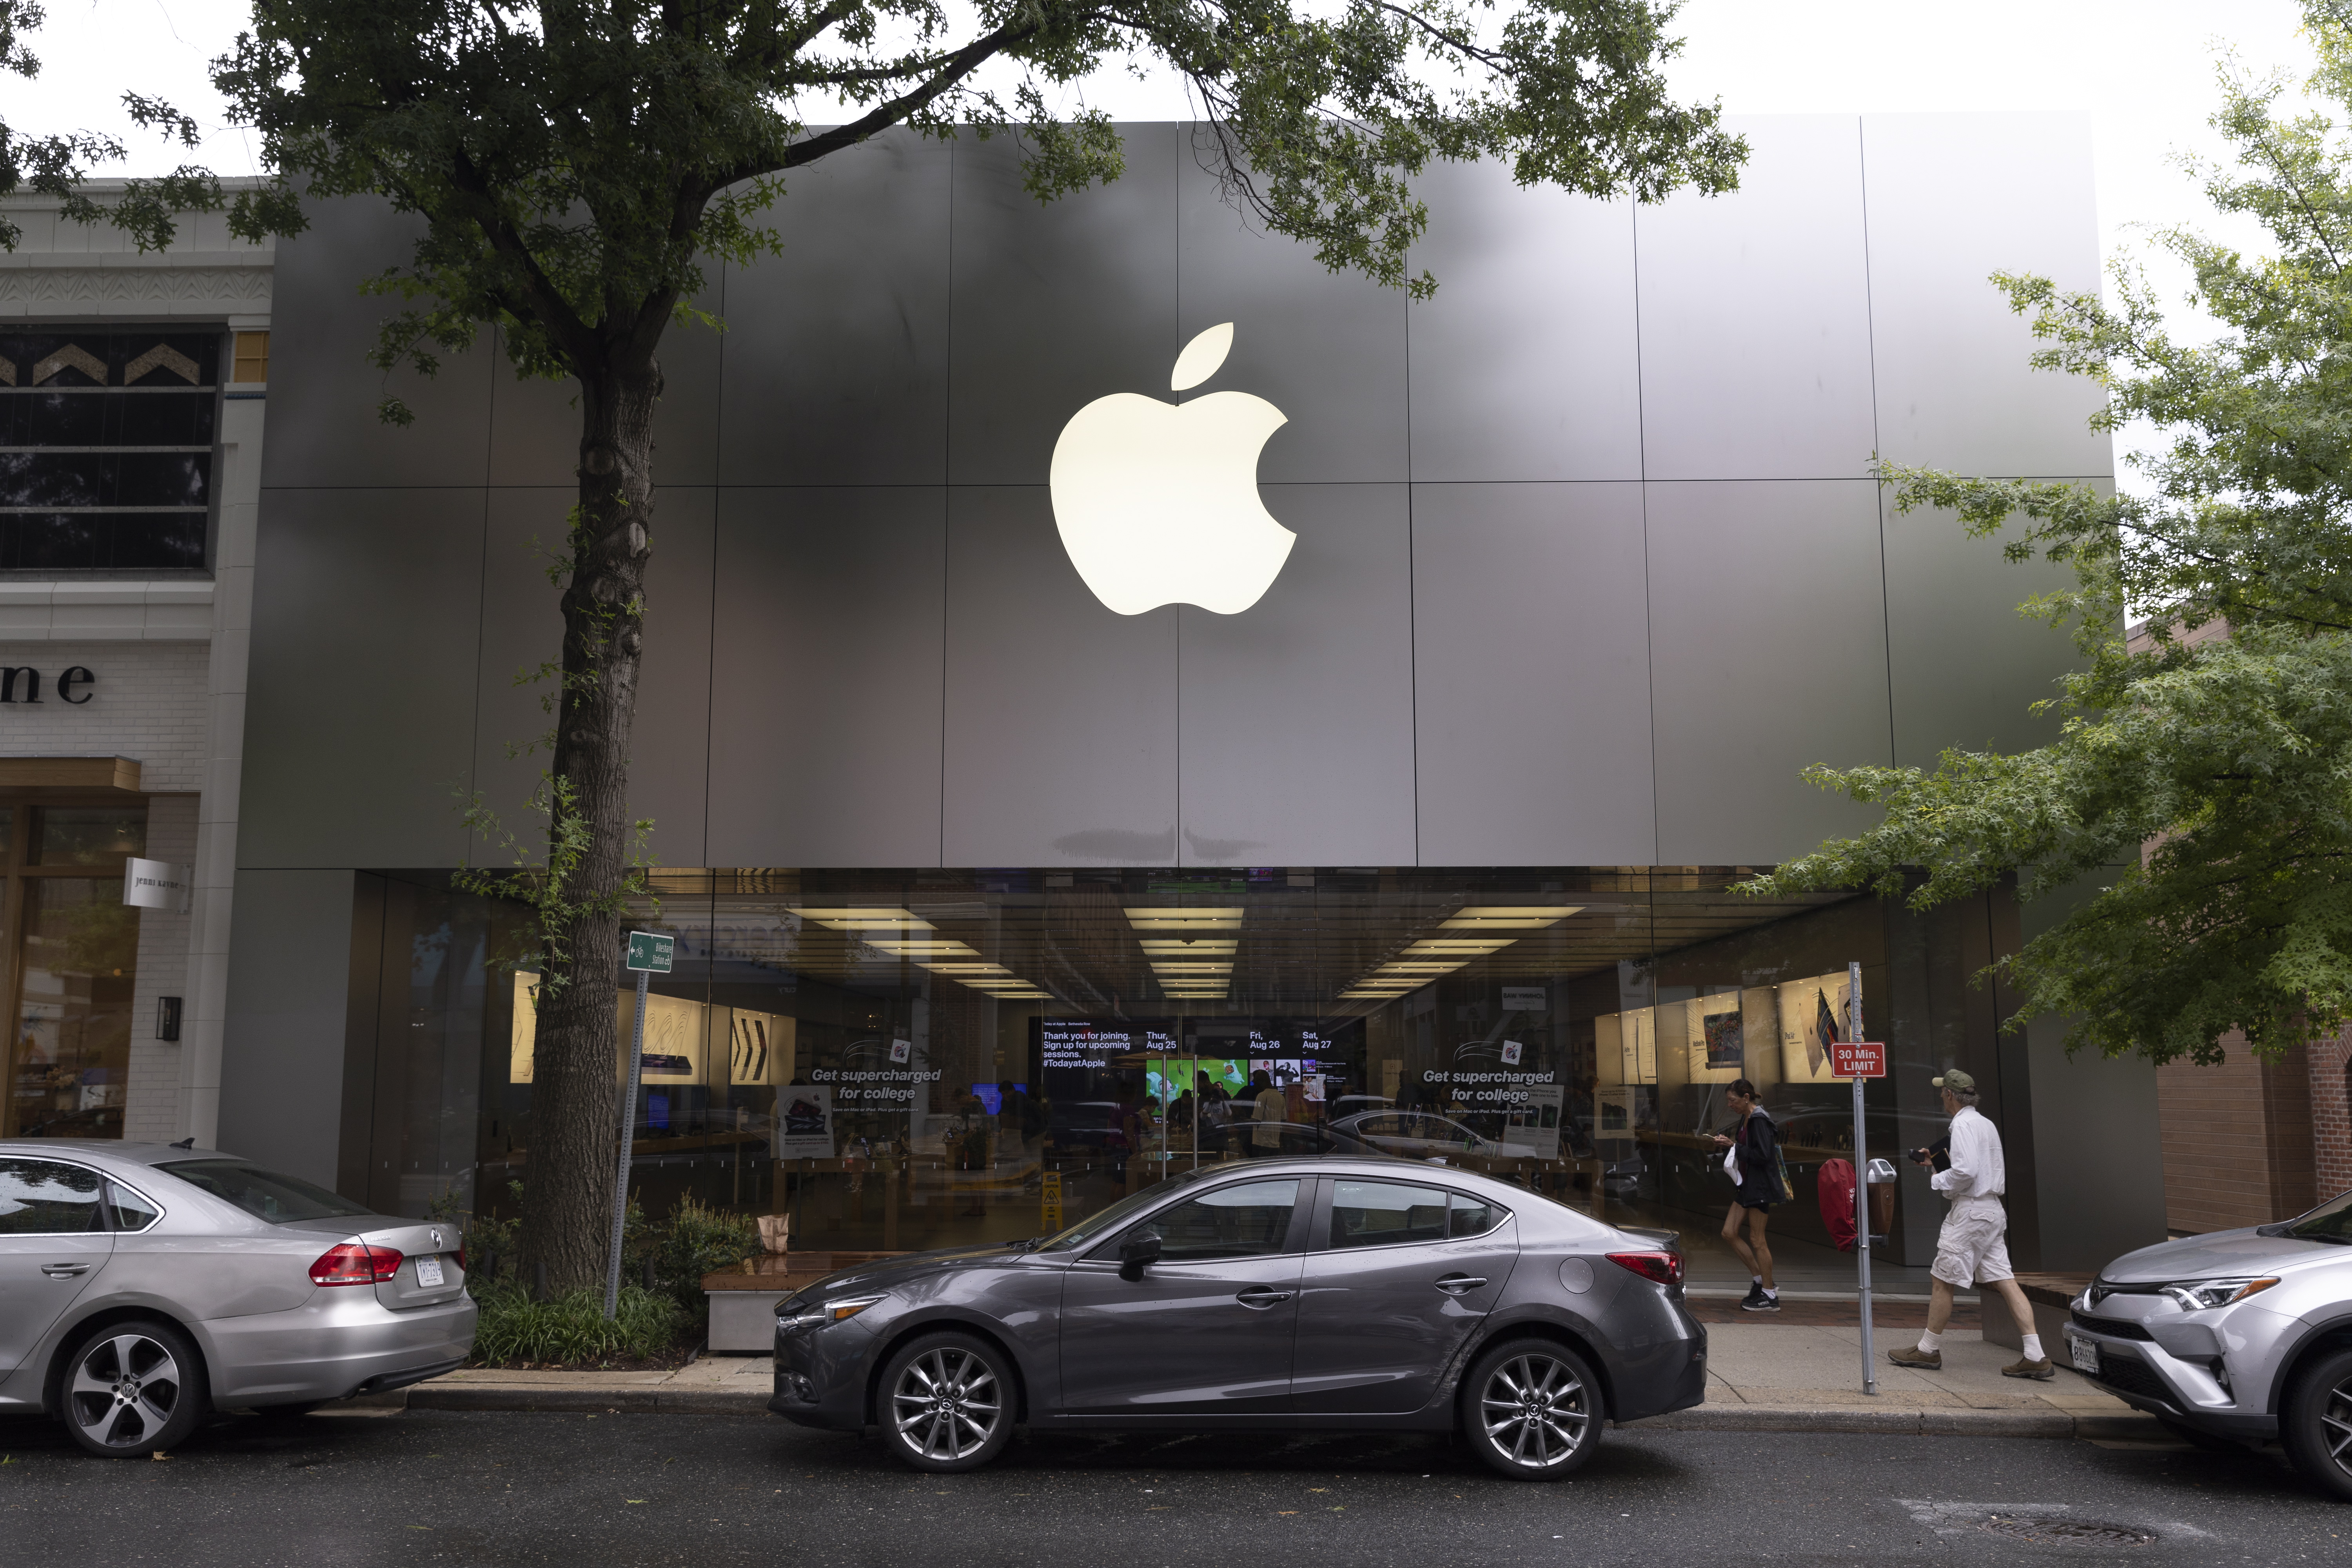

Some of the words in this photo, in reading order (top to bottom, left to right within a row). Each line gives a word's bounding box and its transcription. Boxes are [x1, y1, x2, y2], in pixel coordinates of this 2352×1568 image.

[135, 877, 155, 887] jenni
[158, 880, 179, 891] kayne
[656, 942, 672, 953] Bikeshare
[652, 955, 664, 964] Station
[1100, 1032, 1131, 1041] joining.
[1147, 1032, 1168, 1040] Thur,
[1250, 1032, 1263, 1040] Fri,
[1303, 1032, 1318, 1040] Sat,
[1044, 1041, 1061, 1050] Sign
[1089, 1041, 1130, 1050] upcoming
[1147, 1041, 1163, 1050] Aug
[1250, 1041, 1267, 1050] Aug
[1303, 1041, 1319, 1050] Aug
[1838, 1050, 1852, 1059] 30
[1856, 1050, 1879, 1059] Min.
[1044, 1060, 1105, 1068] #TodayatApple
[1844, 1062, 1875, 1071] LIMIT
[812, 1069, 837, 1080] Get
[841, 1069, 942, 1083] supercharged
[1424, 1070, 1449, 1082] Get
[1452, 1071, 1554, 1085] supercharged
[839, 1087, 860, 1098] for
[864, 1087, 915, 1102] college
[1452, 1088, 1473, 1100] for
[1476, 1089, 1529, 1103] college
